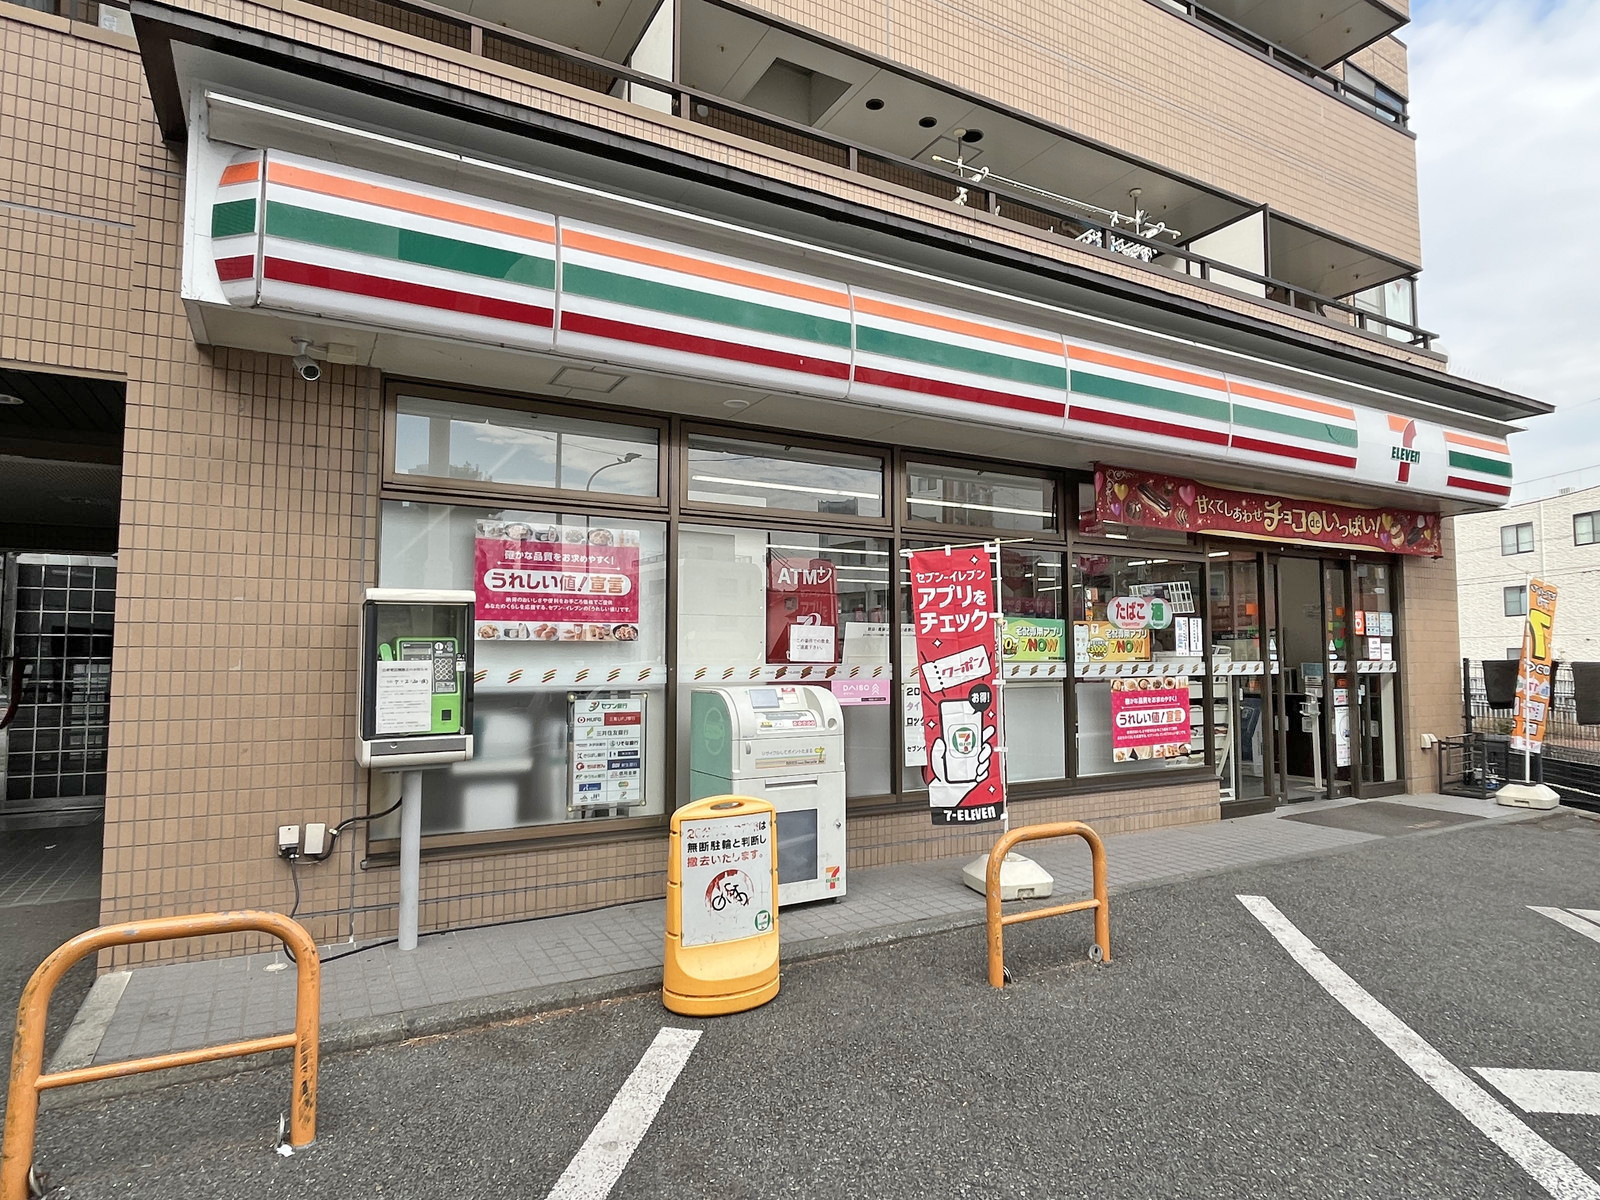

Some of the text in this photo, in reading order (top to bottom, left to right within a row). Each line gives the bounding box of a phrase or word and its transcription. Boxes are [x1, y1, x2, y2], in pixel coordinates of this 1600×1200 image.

[1387, 414, 1417, 482] 7
[1195, 495, 1262, 523] 甘くてしあわせ
[491, 572, 624, 594] うれしい値!宣言
[917, 585, 987, 609] アプリを
[1115, 601, 1146, 620] たばこ
[920, 609, 988, 634] チェック
[1021, 638, 1059, 652] 7NOW
[1110, 640, 1144, 653] 7NOW
[941, 657, 985, 678] クーポン
[906, 687, 920, 696] 20
[687, 835, 767, 853] 無断駐輪と判断し
